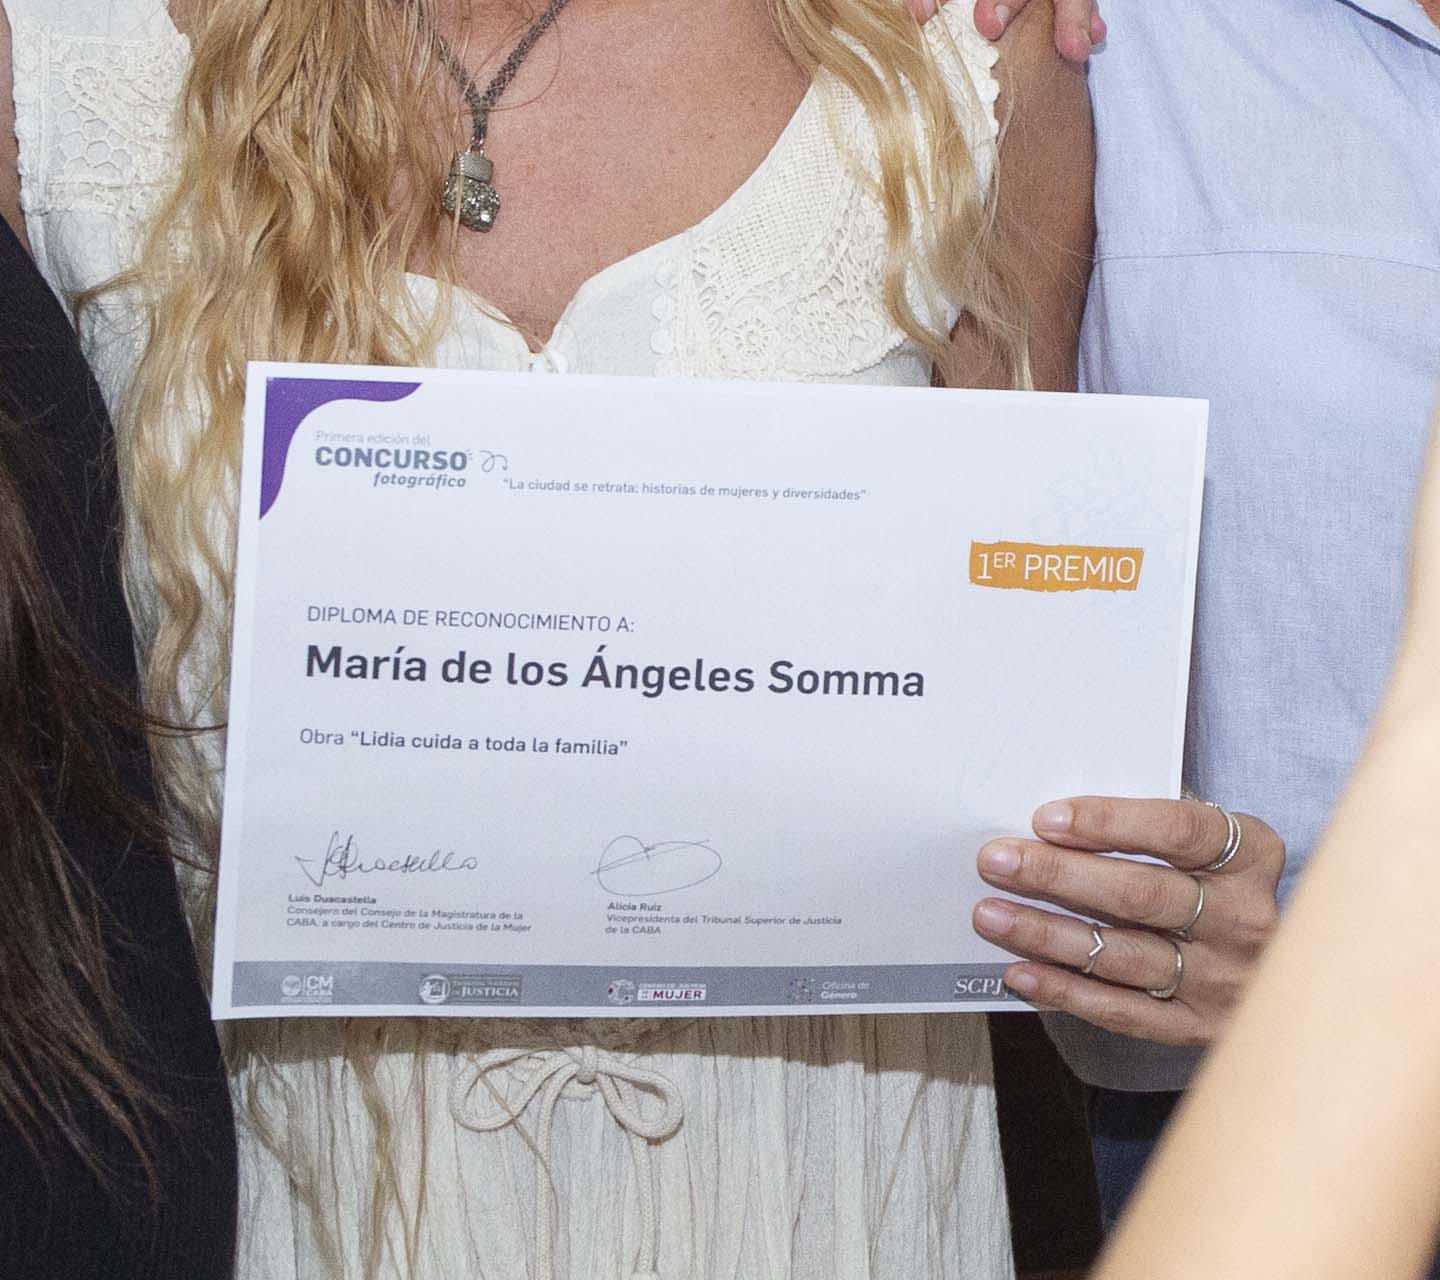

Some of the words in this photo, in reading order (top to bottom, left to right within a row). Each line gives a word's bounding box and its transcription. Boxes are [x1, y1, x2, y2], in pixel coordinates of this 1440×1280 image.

[315, 430, 364, 444] Primera
[367, 433, 409, 445] edición
[412, 434, 430, 447] del
[315, 446, 468, 471] CONCURSO
[373, 471, 467, 490] fotográfico
[528, 479, 570, 491] ciudad
[574, 482, 589, 492] se
[592, 482, 639, 494] retrata:
[642, 483, 696, 496] historias
[699, 484, 715, 496] de
[718, 486, 769, 499] mujeres
[772, 489, 779, 500] y
[1024, 554, 1137, 584] PREMIO
[307, 606, 397, 625] DIPLOMA
[403, 609, 429, 627] DE
[435, 611, 611, 632] RECONOCIMIENTO
[616, 617, 635, 633] A:
[306, 644, 427, 682] María
[441, 650, 492, 685] de
[507, 652, 569, 687] los
[581, 644, 755, 698] Ángeles
[767, 660, 925, 697] Somma
[300, 728, 345, 746] Obra
[411, 733, 462, 750] cuida
[468, 739, 479, 751] a
[485, 736, 526, 752] toda
[532, 737, 549, 754] la
[288, 894, 310, 903] Luis
[287, 906, 340, 917] Consejero
[342, 907, 358, 917] del
[361, 907, 402, 919] Consejo
[404, 909, 417, 918] de
[419, 909, 429, 918] la
[432, 909, 497, 921] Magistratura
[499, 911, 511, 920] de
[513, 911, 524, 921] la
[608, 902, 637, 911] Alicia
[640, 903, 662, 912] Ruiz
[331, 920, 360, 929] cargo
[363, 919, 378, 928] del
[381, 920, 416, 929] Centro
[418, 921, 431, 929] de
[434, 921, 474, 931] Justicia
[476, 922, 488, 930] de
[491, 922, 501, 931] la
[503, 923, 532, 933] Mujer
[606, 914, 680, 925] Vicepresidenta
[683, 915, 698, 924] del
[701, 915, 742, 925] Tribunal
[745, 916, 786, 927] Superior
[789, 916, 801, 925] de
[803, 916, 843, 926] Justicia
[605, 925, 617, 934] de
[620, 925, 629, 934] la
[632, 926, 661, 934] CABA
[307, 975, 333, 989] CM
[461, 985, 519, 997] JUSTICIA
[653, 990, 703, 1000] MUJER
